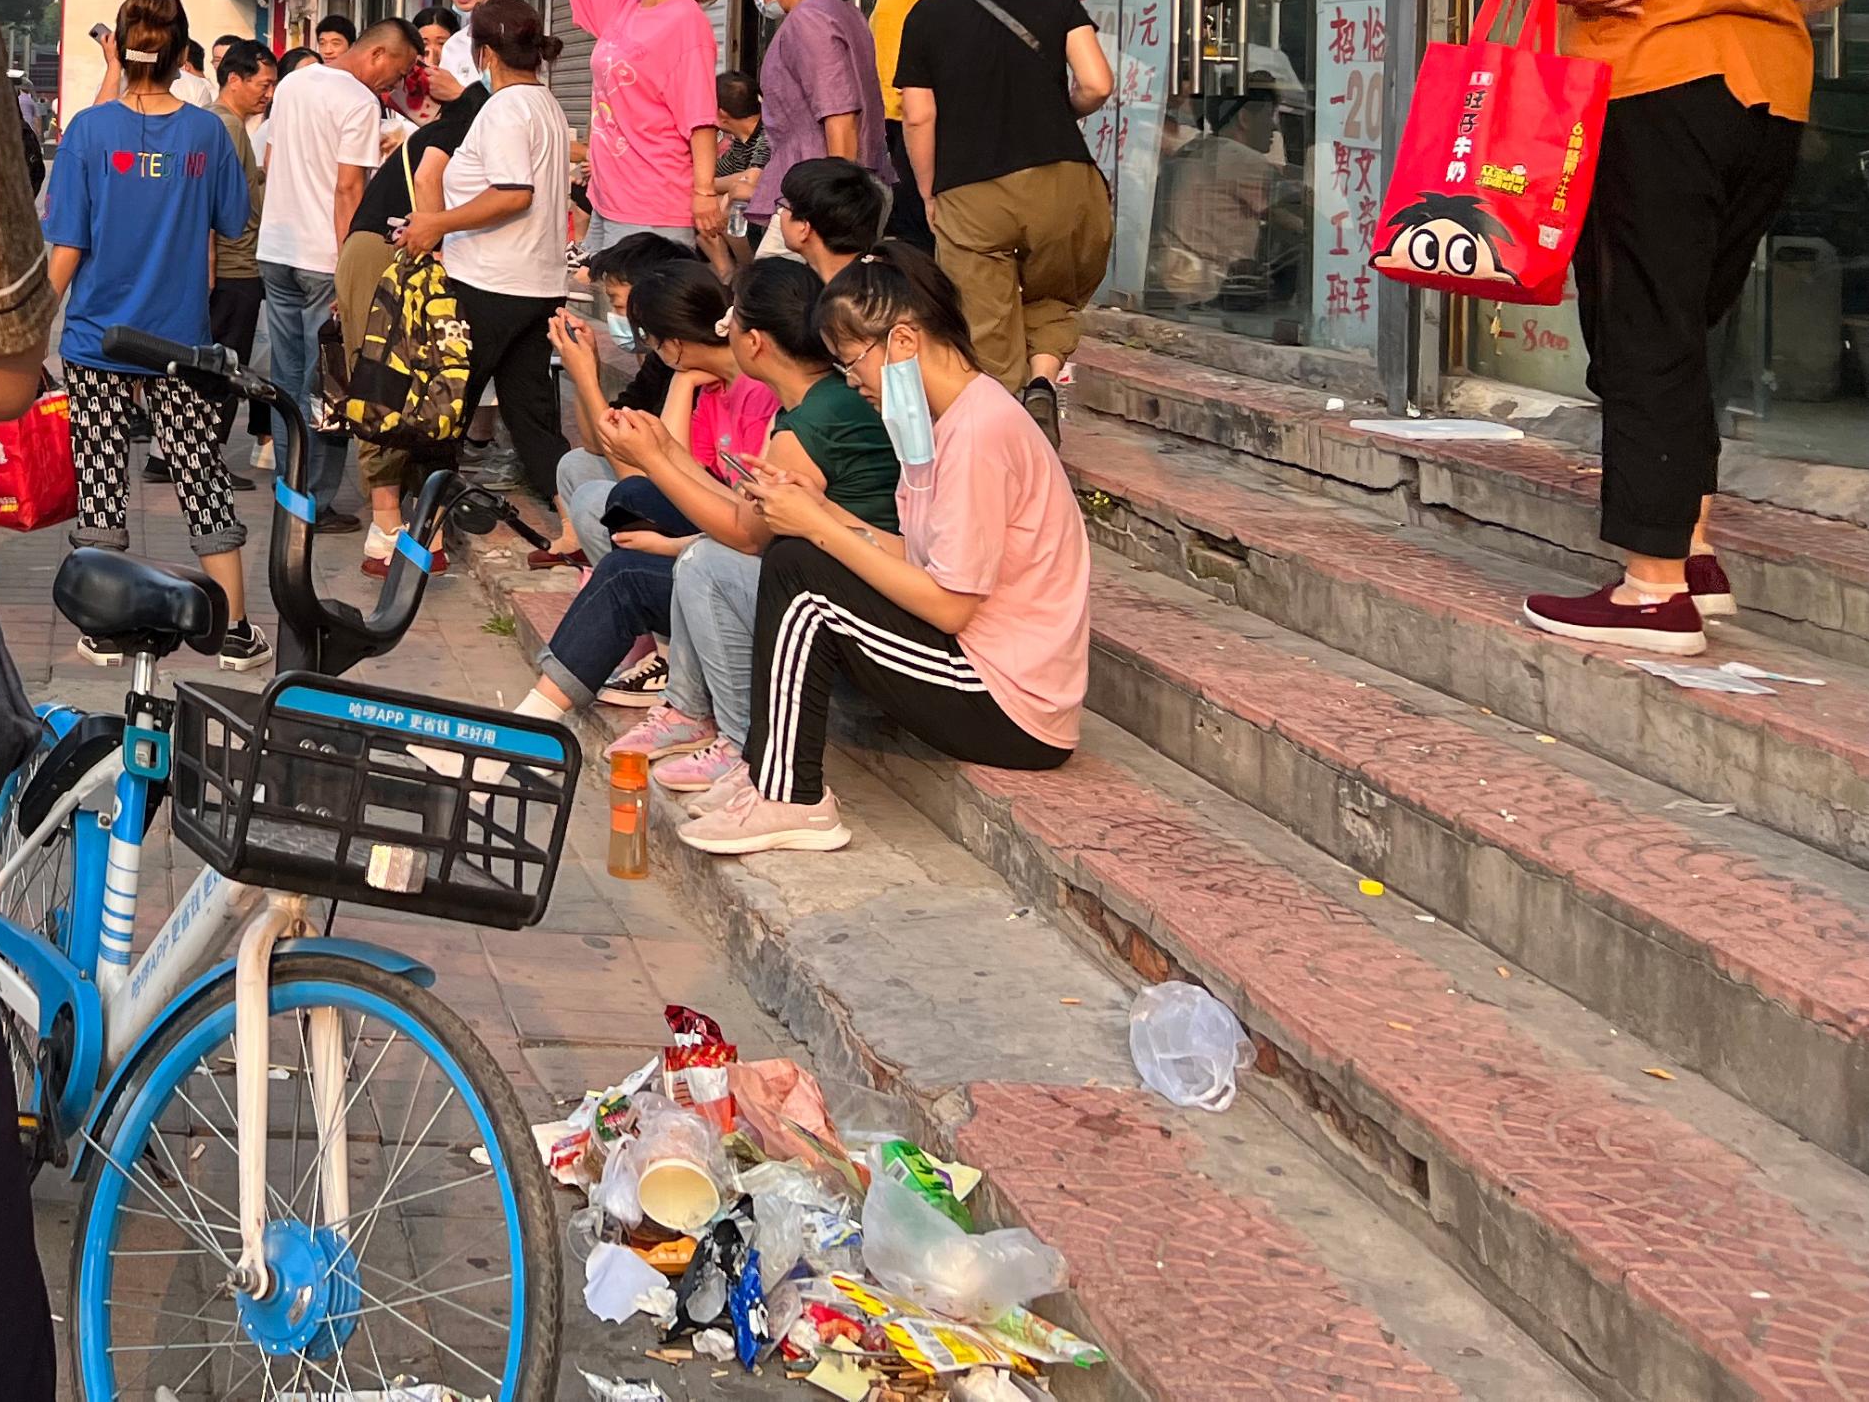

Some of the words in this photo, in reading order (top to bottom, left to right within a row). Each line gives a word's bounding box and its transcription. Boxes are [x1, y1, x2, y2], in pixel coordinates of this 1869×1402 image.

[1445, 89, 1489, 183] 旺仔牛奶
[409, 712, 451, 736] 更省钱
[456, 722, 497, 745] 更好用
